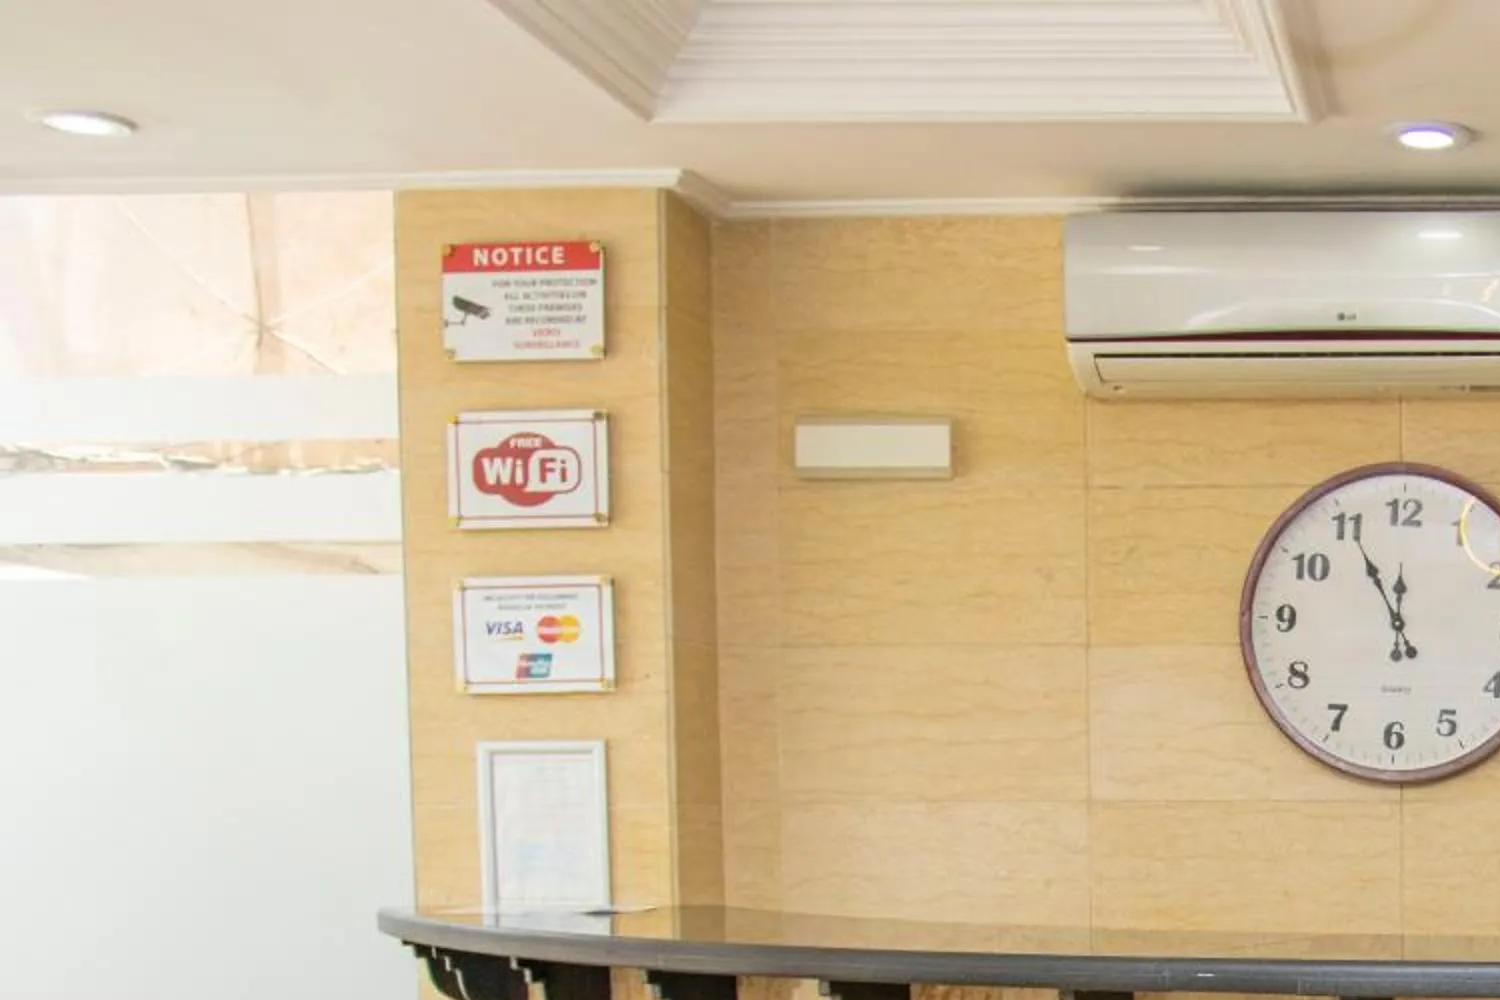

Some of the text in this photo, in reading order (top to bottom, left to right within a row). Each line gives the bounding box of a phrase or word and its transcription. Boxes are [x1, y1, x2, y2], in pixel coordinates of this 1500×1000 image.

[472, 246, 566, 267] NOTICE
[509, 438, 543, 449] FREE
[1331, 511, 1363, 542] 11
[1386, 498, 1423, 528] 12
[1292, 553, 1331, 582] 10
[486, 620, 523, 635] VISA
[1275, 603, 1297, 633] 9
[1287, 660, 1310, 689] 8
[1327, 703, 1349, 732] 7
[1436, 708, 1457, 737] 5
[1383, 721, 1405, 750] 6
